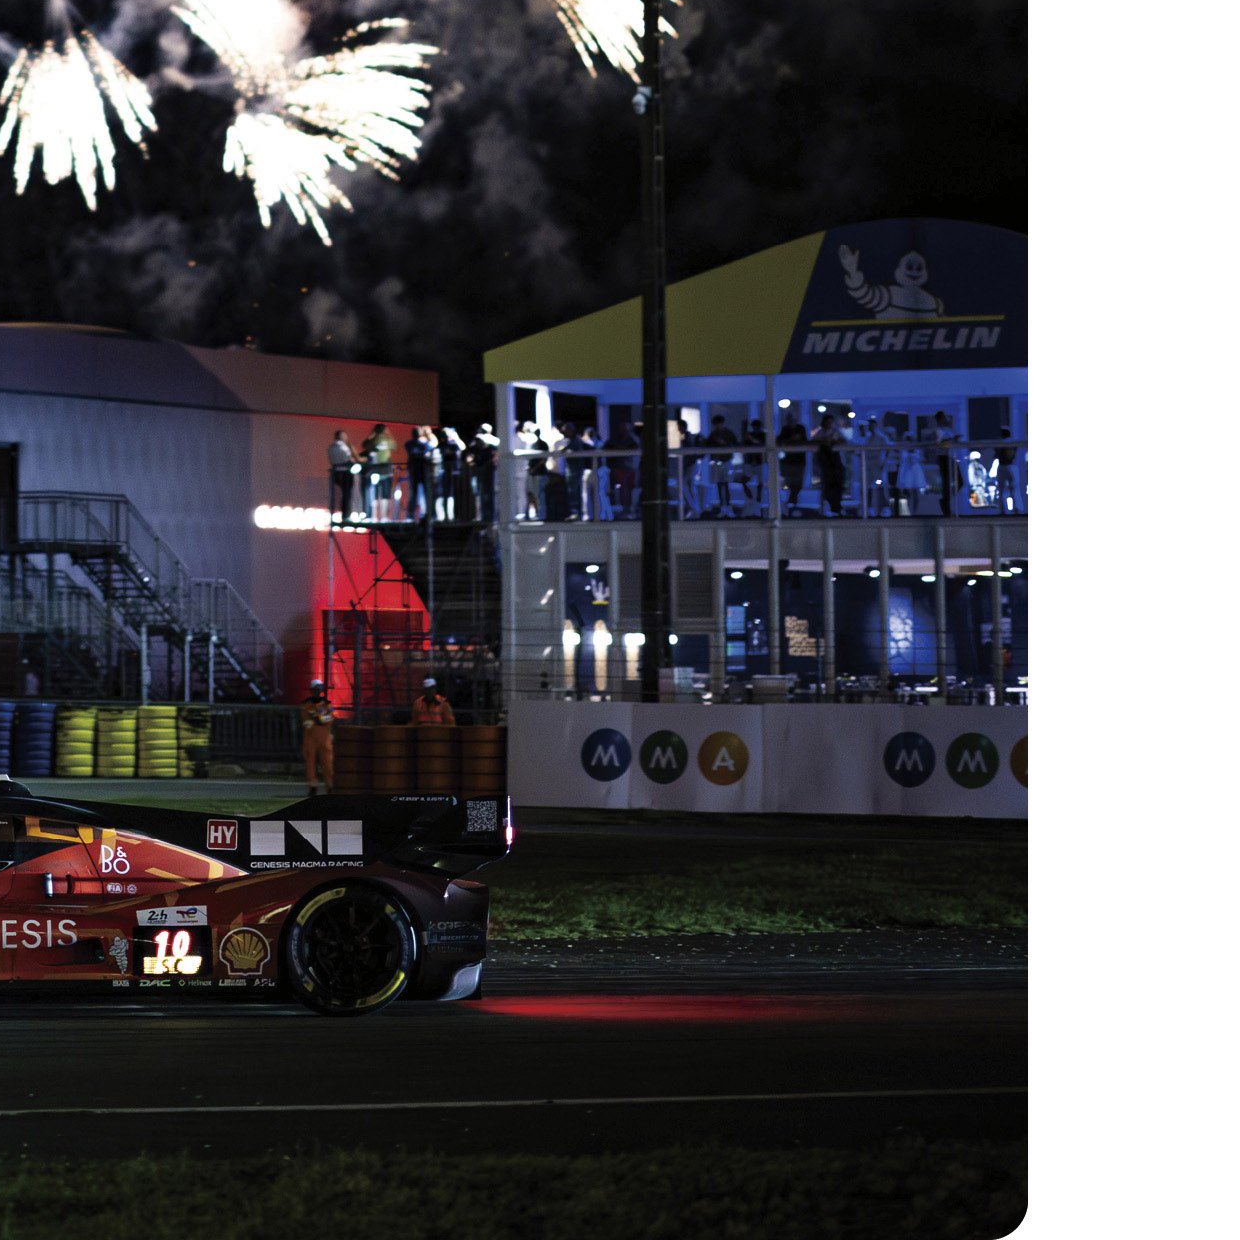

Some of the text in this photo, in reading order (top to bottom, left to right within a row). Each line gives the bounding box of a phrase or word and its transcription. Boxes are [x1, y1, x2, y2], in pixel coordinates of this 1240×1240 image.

[801, 326, 1002, 354] MICHELIN
[210, 825, 235, 844] HY
[250, 861, 291, 869] GENESIS
[292, 860, 327, 868] MAGMA
[154, 929, 191, 958] 10
